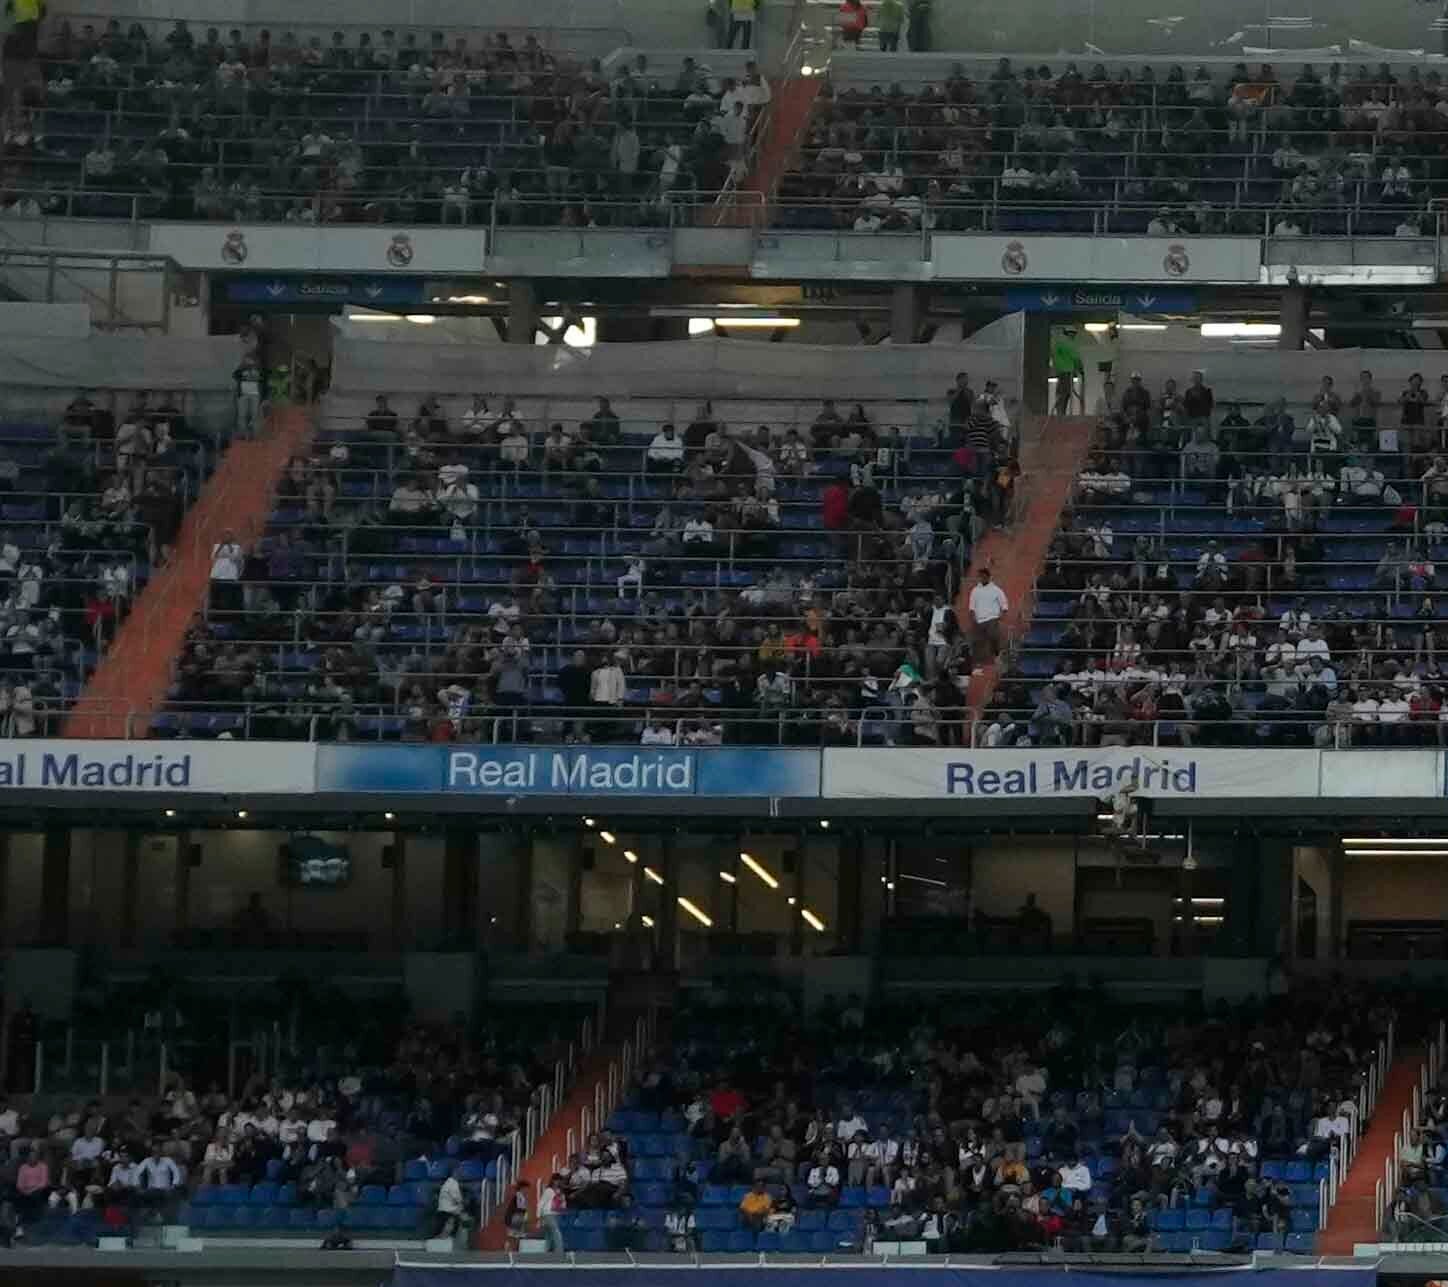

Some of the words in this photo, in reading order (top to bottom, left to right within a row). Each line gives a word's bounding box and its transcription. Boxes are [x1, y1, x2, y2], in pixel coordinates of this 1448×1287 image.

[1075, 292, 1121, 304] Salida
[40, 752, 192, 784] Madrid
[451, 752, 535, 786] Real
[552, 754, 690, 788] Madrid
[945, 765, 1039, 793] Real
